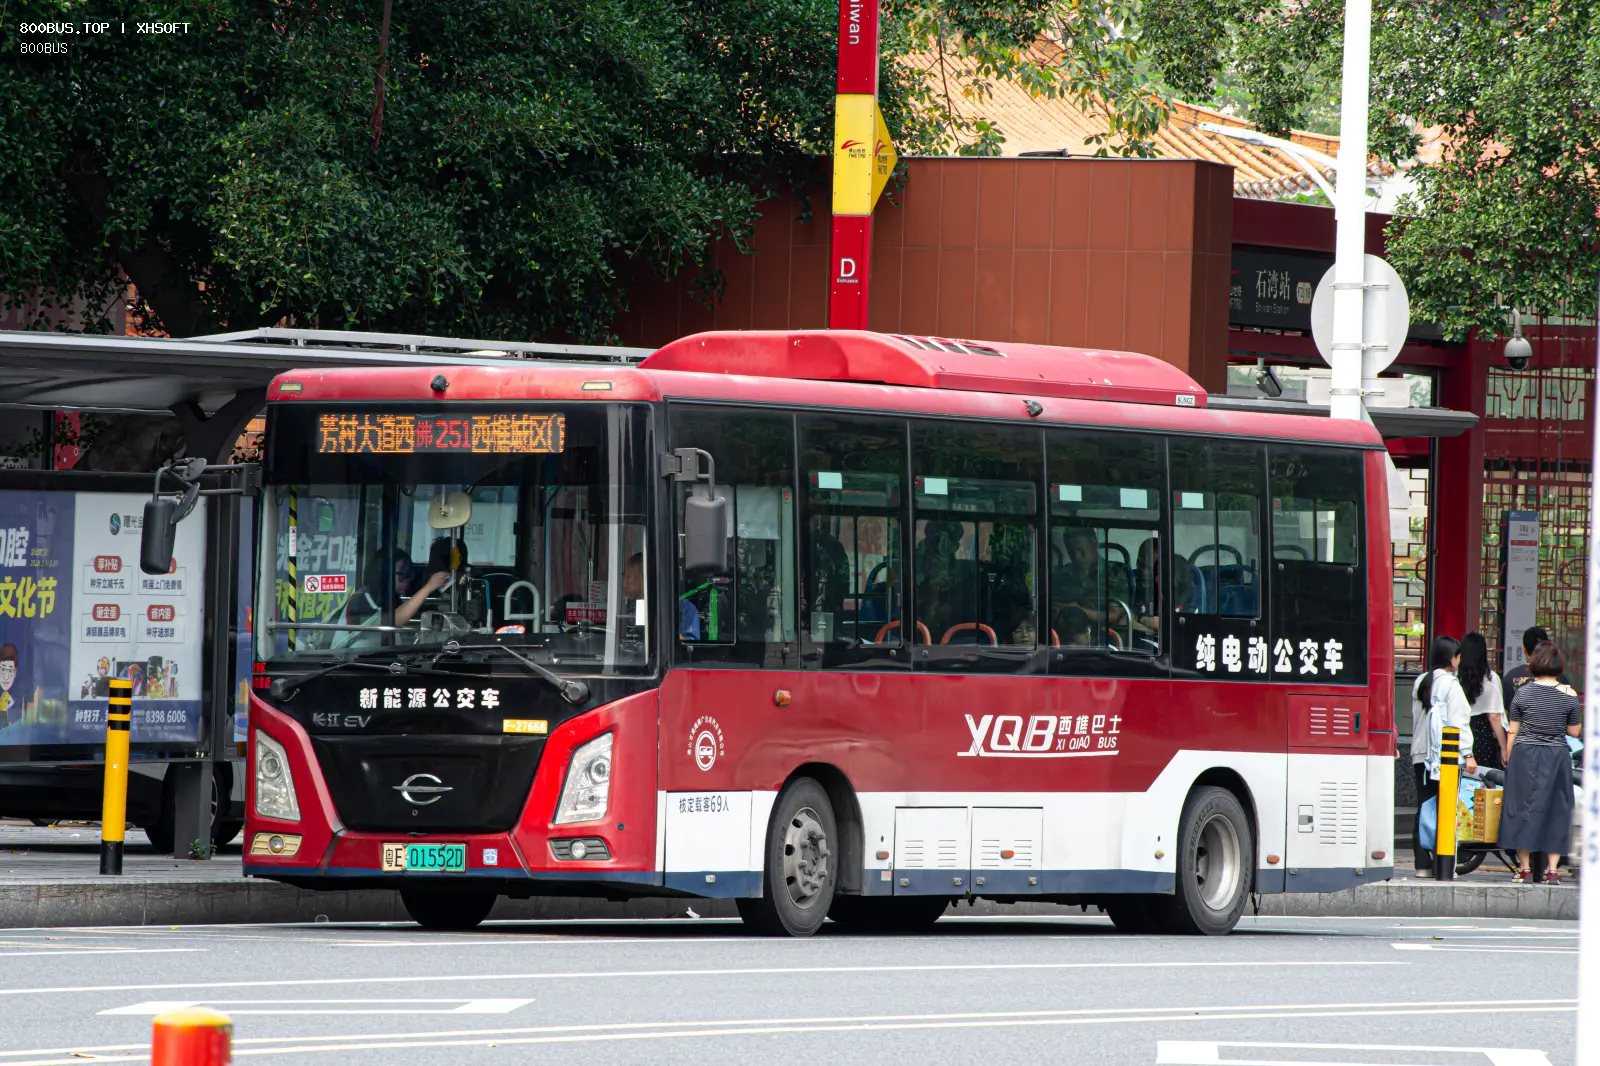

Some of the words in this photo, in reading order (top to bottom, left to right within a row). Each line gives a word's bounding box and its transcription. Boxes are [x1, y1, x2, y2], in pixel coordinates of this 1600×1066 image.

[848, 0, 864, 45] iwan
[840, 258, 856, 277] D
[1255, 269, 1291, 300] 石湾站
[1195, 634, 1344, 675] 纯电动公交车
[359, 687, 500, 709] 新能源公交车
[145, 710, 165, 723] 8398
[167, 710, 187, 723] 6006
[312, 712, 341, 728] 长江
[344, 715, 372, 728] EV
[1058, 714, 1123, 735] 西樵巴士
[1056, 738, 1066, 751] XI
[1069, 736, 1091, 750] QIAO
[1097, 736, 1118, 749] BUS
[679, 795, 730, 813] 核定载客69人
[410, 848, 463, 867] 01552D
